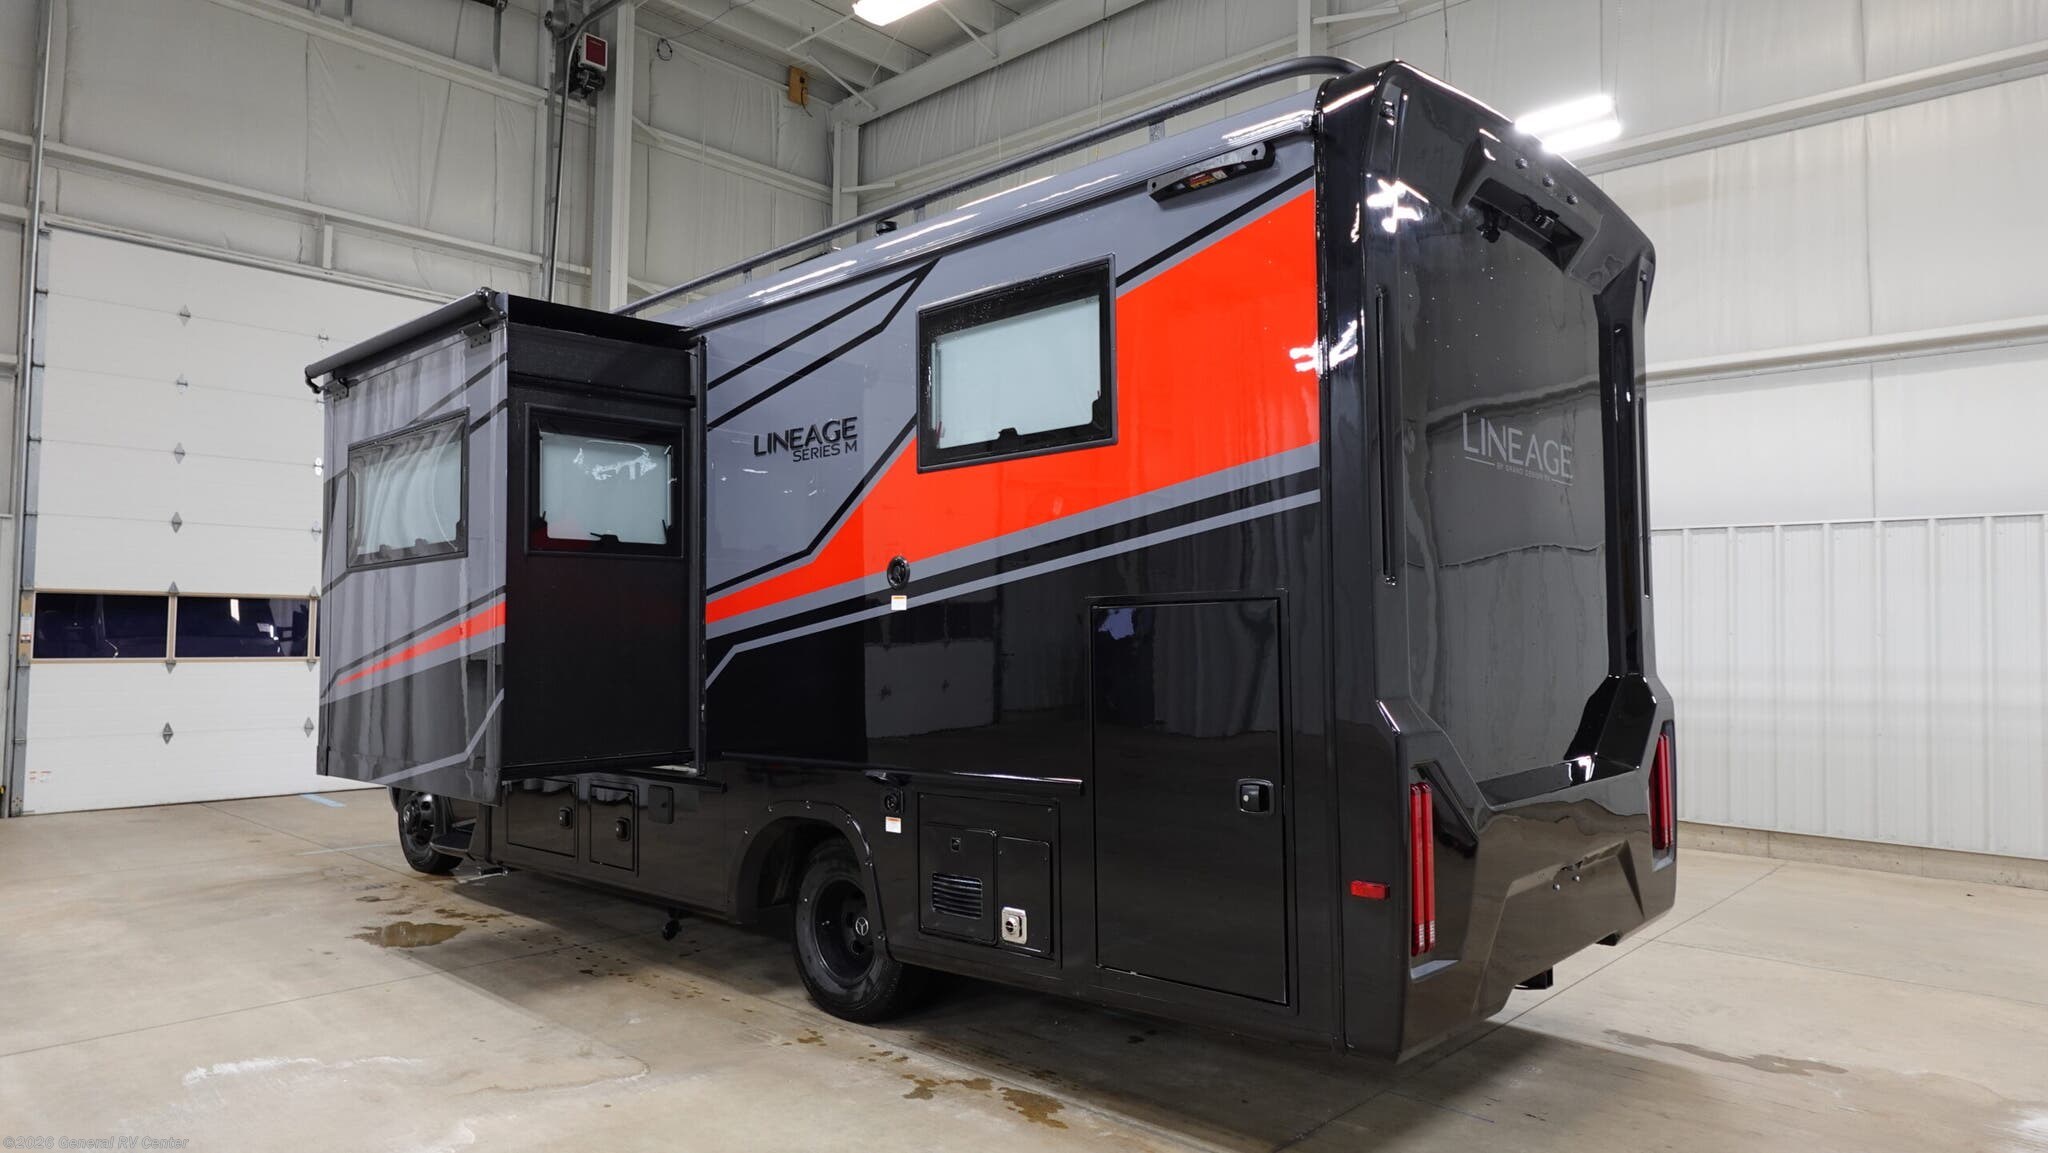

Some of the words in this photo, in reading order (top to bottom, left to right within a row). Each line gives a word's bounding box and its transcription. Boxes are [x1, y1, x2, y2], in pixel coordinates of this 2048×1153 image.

[754, 416, 858, 457] LINEAGE
[792, 443, 840, 462] SERIES
[844, 440, 858, 454] M
[1462, 412, 1574, 479] LINEAGE
